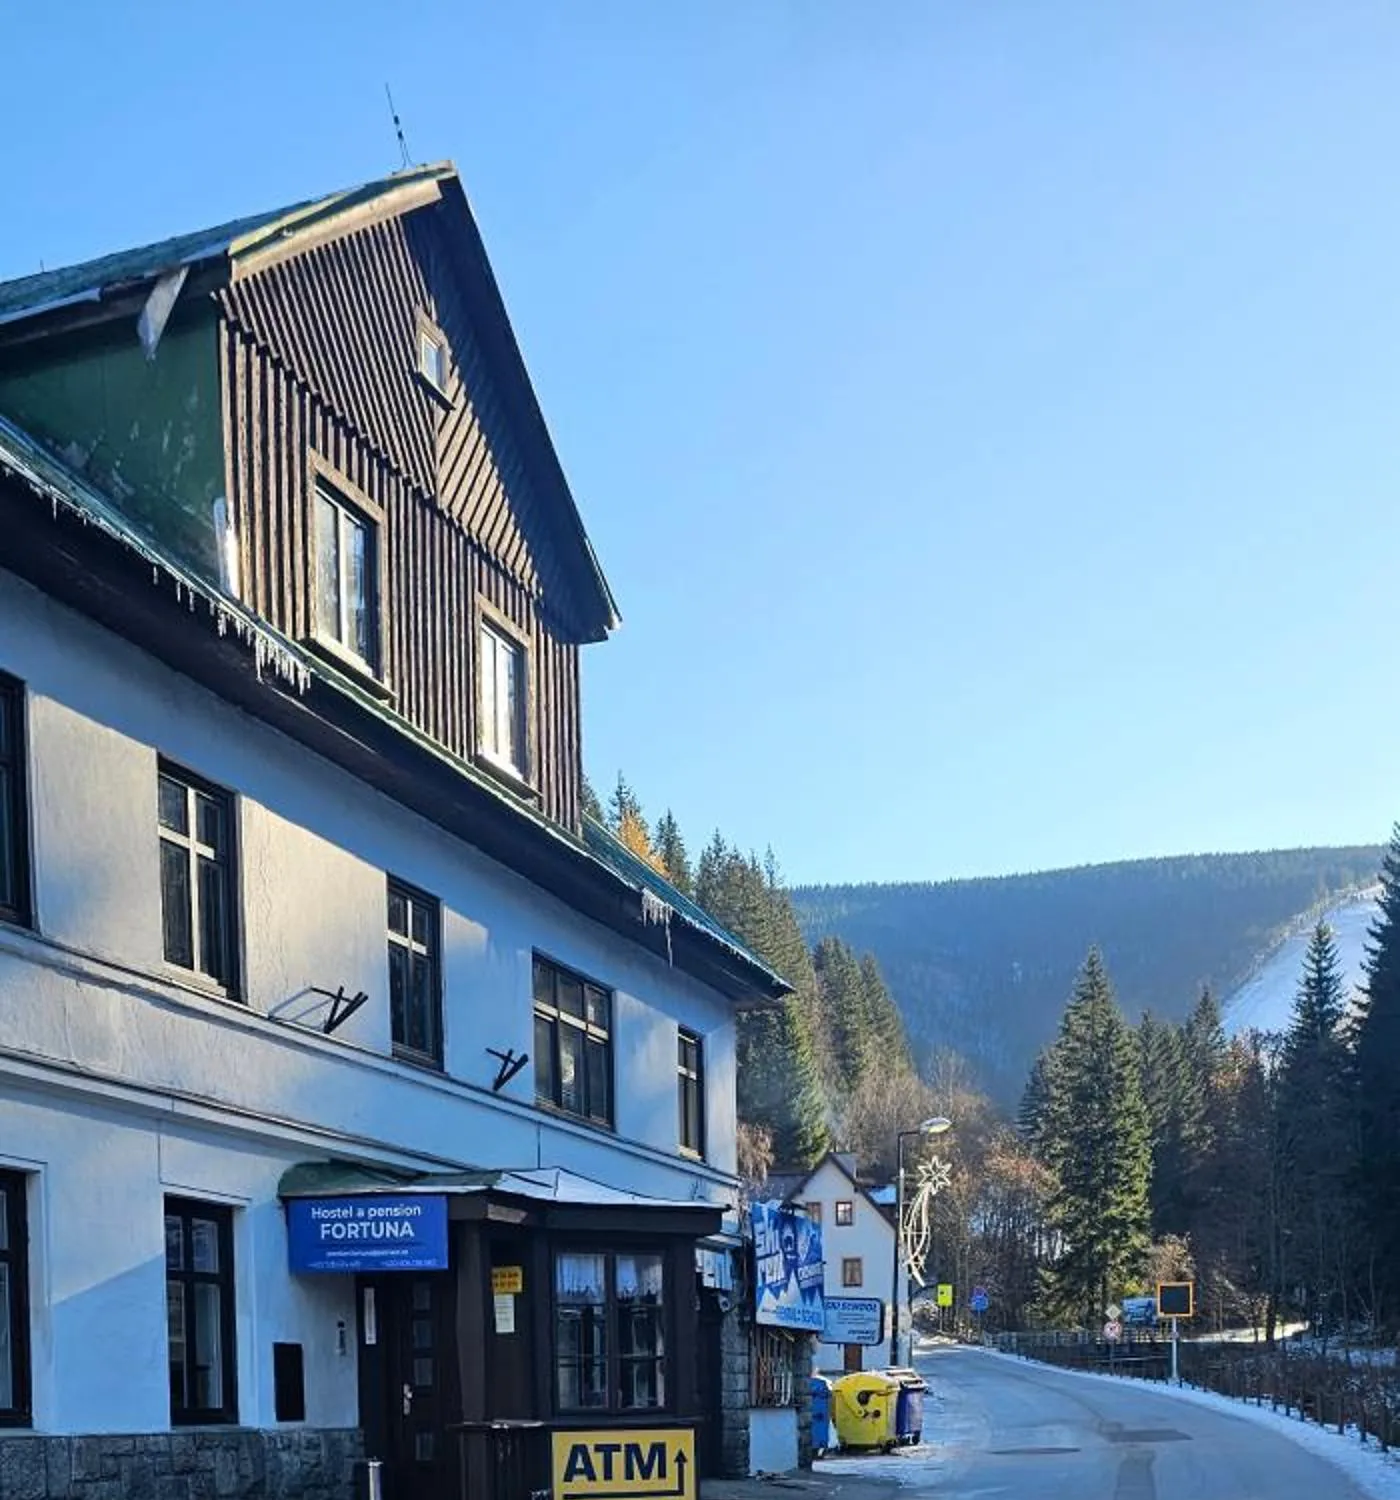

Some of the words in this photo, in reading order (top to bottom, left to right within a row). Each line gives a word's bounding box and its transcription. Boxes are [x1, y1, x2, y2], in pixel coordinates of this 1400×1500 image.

[311, 1206, 353, 1219] Hostel
[356, 1209, 365, 1217] a
[367, 1204, 422, 1220] pension
[320, 1221, 415, 1240] FORTUNA
[563, 1441, 667, 1482] ATM
